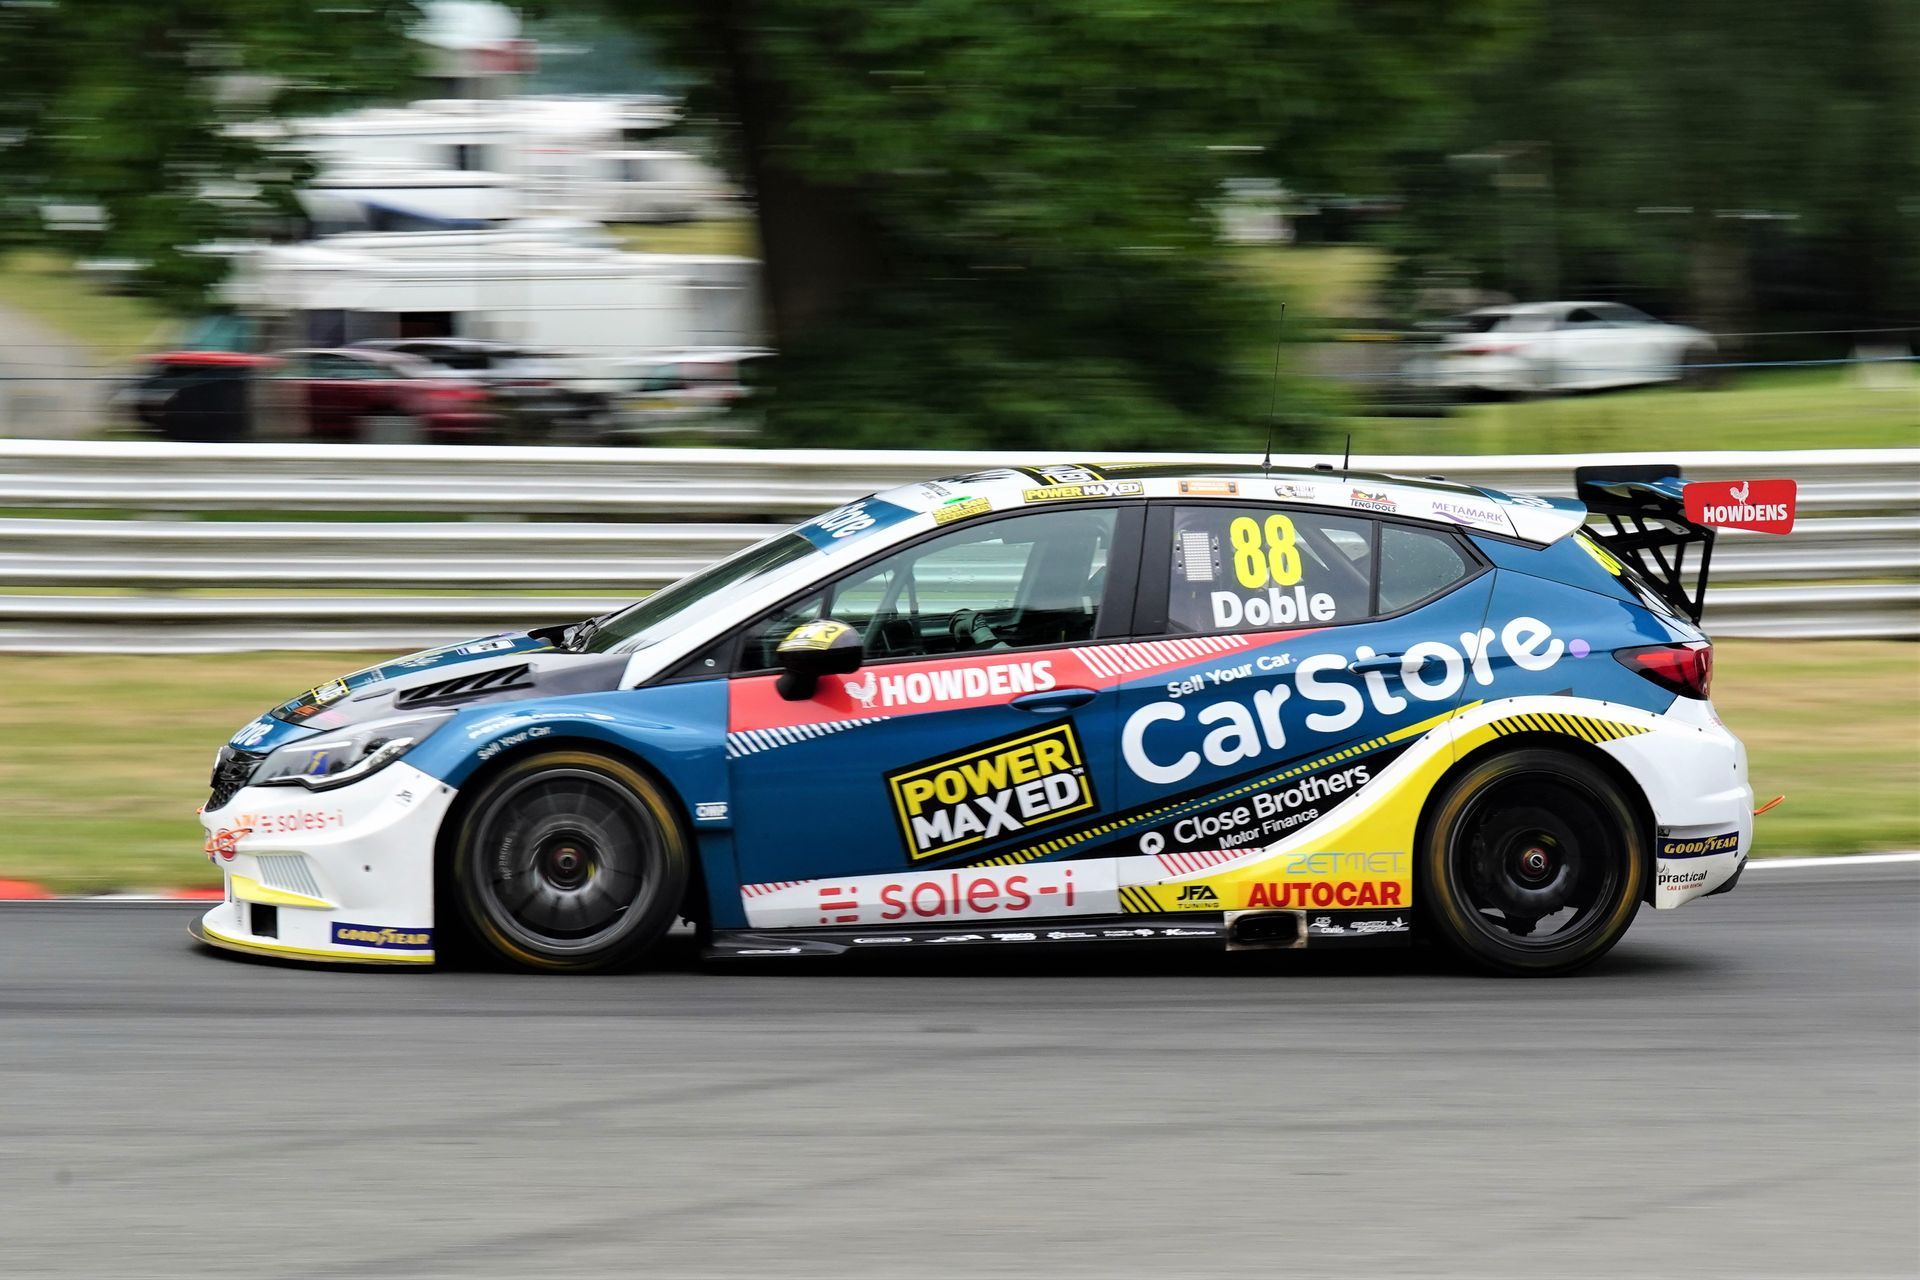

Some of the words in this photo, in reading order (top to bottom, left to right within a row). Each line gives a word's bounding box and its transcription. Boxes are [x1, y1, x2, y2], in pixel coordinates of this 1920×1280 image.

[1027, 486, 1082, 499] POWER
[1083, 481, 1139, 496] MAXED
[1432, 501, 1503, 523] METAMARK
[1703, 504, 1788, 523] HOWDENS
[1230, 514, 1302, 588] 88
[1211, 586, 1336, 628] Doble
[879, 660, 1056, 706] HOWDENS
[1167, 674, 1205, 698] Sell
[1205, 663, 1252, 685] Your
[901, 738, 1072, 816] POWER
[911, 772, 1080, 849] MAXED
[1173, 806, 1250, 844] Close
[1252, 764, 1370, 819] Brothers
[278, 809, 344, 832] sales-i
[1219, 827, 1260, 849] Motor
[1262, 807, 1319, 835] Finance
[1664, 836, 1737, 855] GOODYEAR
[1286, 851, 1405, 874] ZETMET
[1658, 870, 1708, 886] practical
[880, 869, 1074, 919] sales-i
[1177, 885, 1218, 900] JFA
[1247, 881, 1402, 908] AUTOCAR
